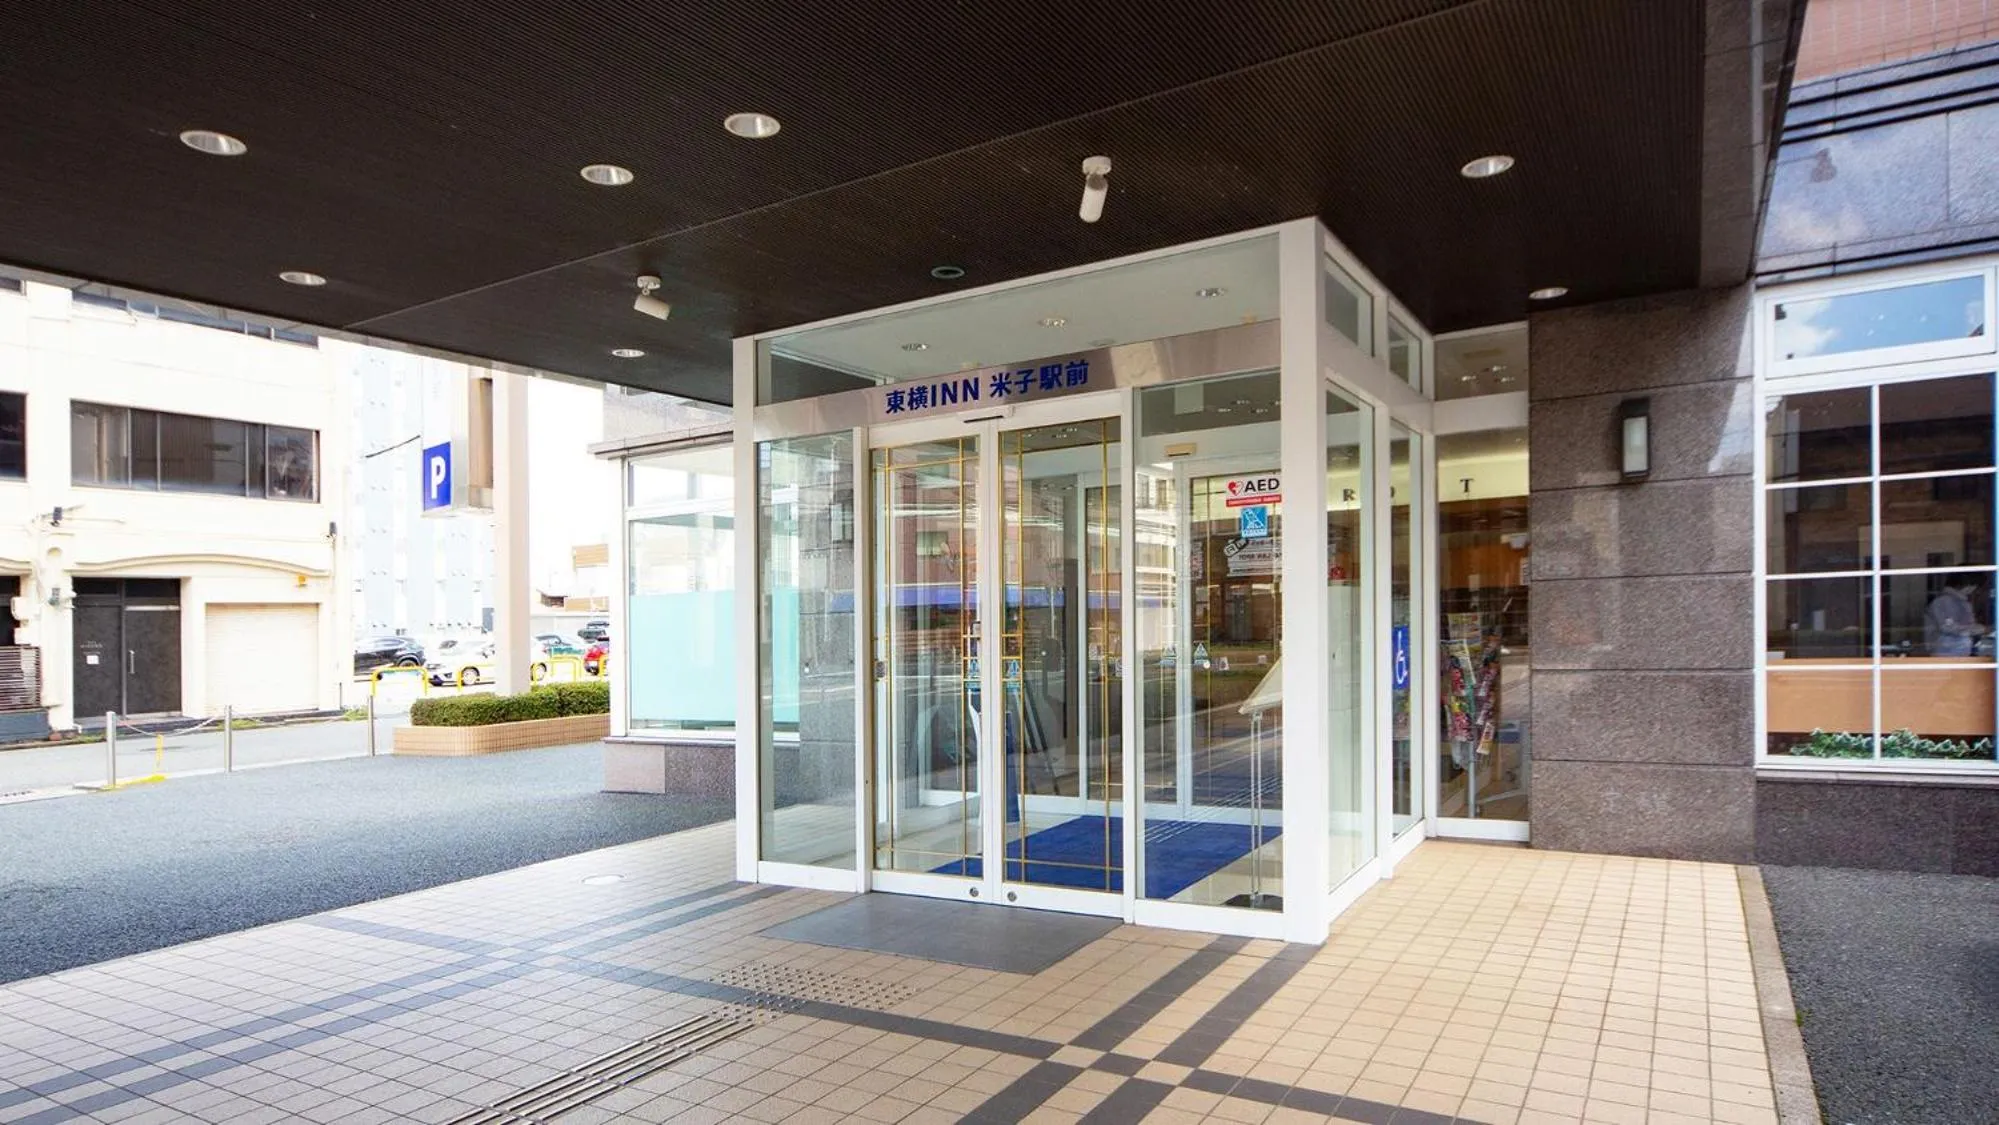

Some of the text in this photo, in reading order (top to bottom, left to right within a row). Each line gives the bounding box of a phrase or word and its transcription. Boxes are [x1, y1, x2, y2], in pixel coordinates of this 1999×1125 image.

[885, 359, 1090, 414] 東横INN 米子駅前
[430, 455, 446, 499] P
[1244, 478, 1280, 492] AED
